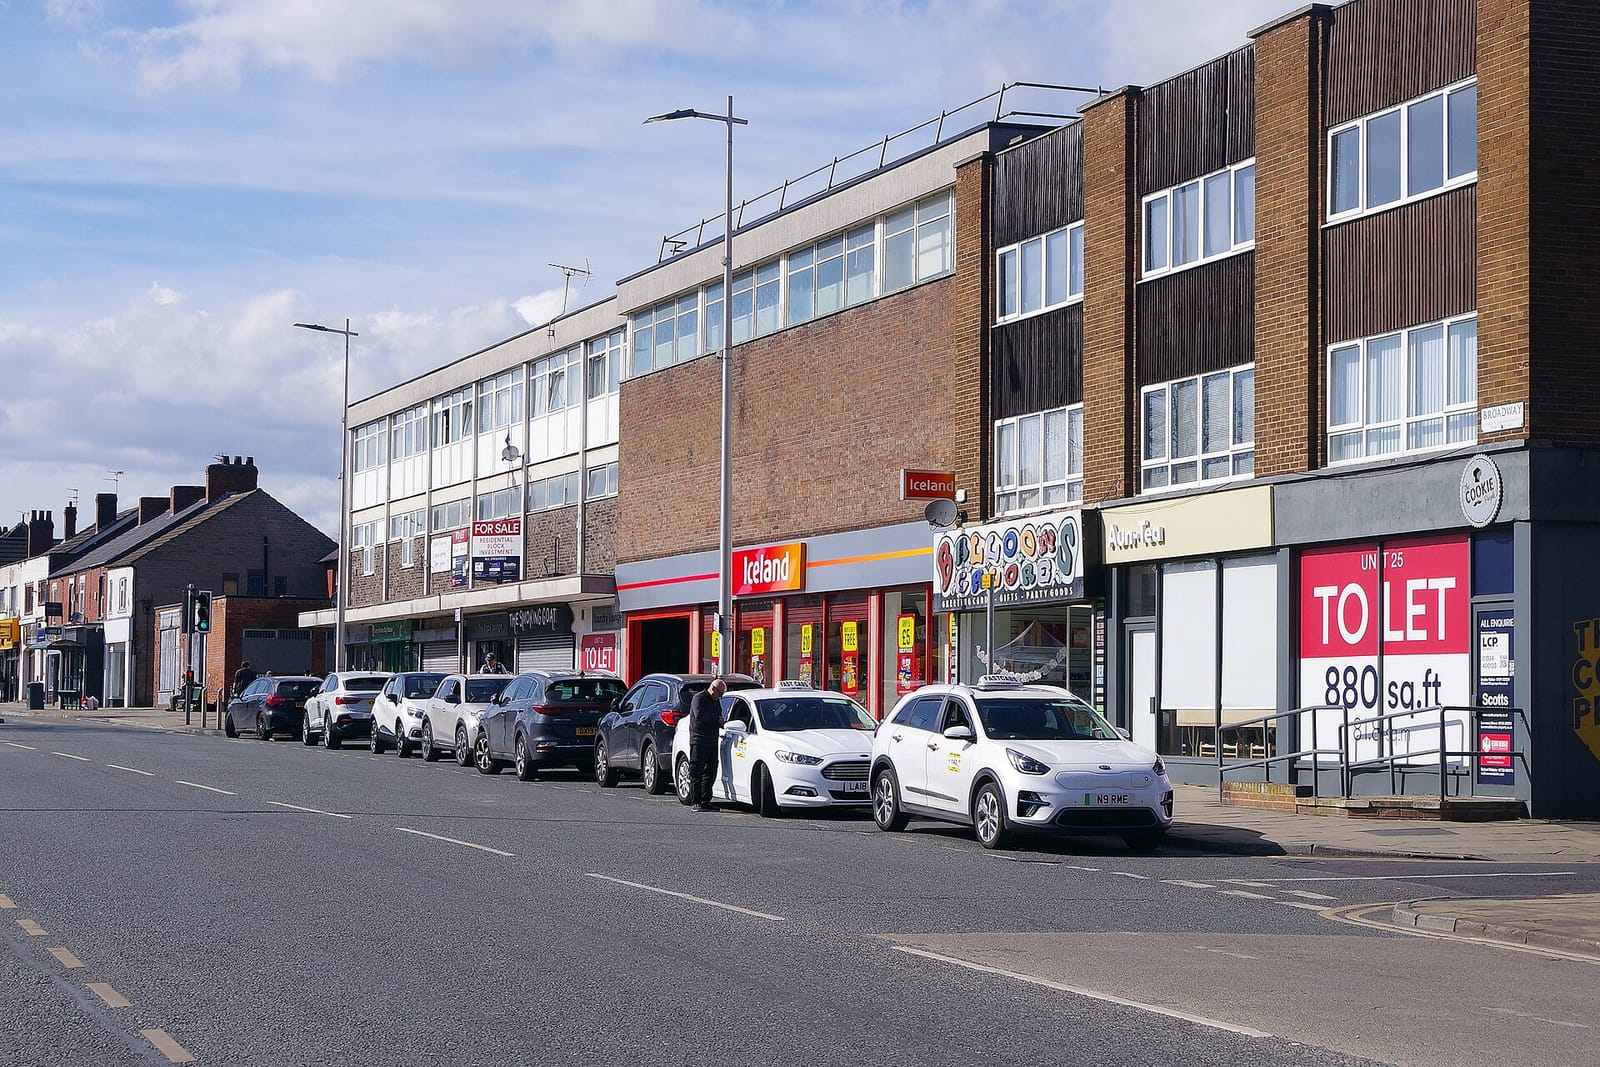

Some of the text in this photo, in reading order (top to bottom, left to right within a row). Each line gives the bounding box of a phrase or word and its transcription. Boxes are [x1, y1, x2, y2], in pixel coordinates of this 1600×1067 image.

[1482, 404, 1522, 420] BROADWAY
[910, 479, 954, 491] Iceland
[1465, 477, 1495, 504] COOKIE
[475, 523, 519, 534] FOR SALE
[937, 521, 1077, 594] BALLOONS
[1361, 552, 1404, 570] UNT 25
[743, 551, 790, 585] Iceland
[942, 586, 1073, 609] GREETING CARD GIFTS PARTY GOODS
[1313, 577, 1456, 645] TO LET
[509, 612, 519, 634] THE
[542, 607, 557, 630] GOAT
[1480, 618, 1514, 628] ALL ENQUIRIE
[844, 633, 856, 646] FREE
[902, 629, 911, 645] £5
[585, 647, 613, 669] TO LET
[1573, 658, 1600, 690] C
[1325, 665, 1441, 719] 880 sq.ft
[1482, 692, 1509, 706] Scotts
[849, 782, 867, 791] LA18
[1097, 794, 1128, 804] N9 RME
